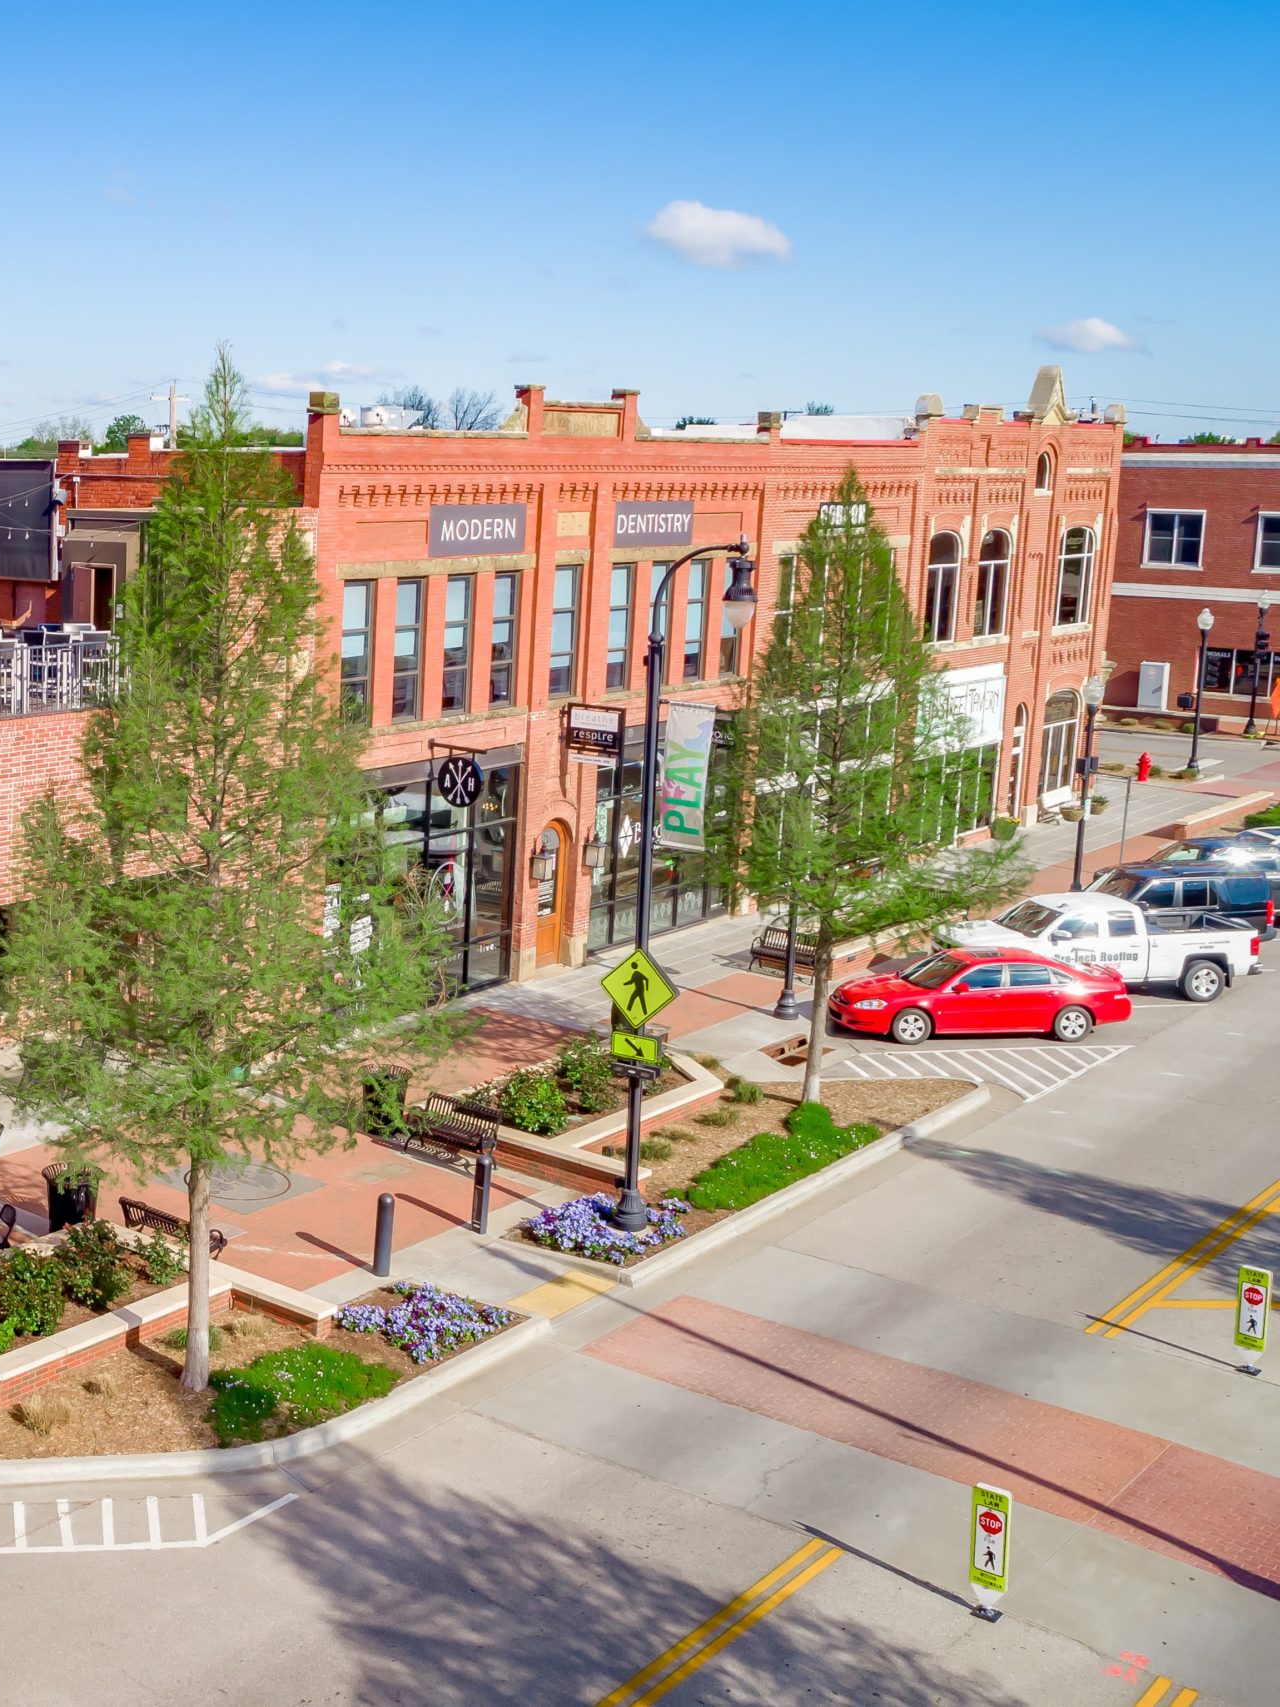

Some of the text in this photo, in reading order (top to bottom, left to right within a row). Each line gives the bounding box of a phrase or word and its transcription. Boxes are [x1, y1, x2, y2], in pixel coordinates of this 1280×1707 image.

[440, 517, 517, 542] MODERN
[616, 513, 692, 535] DENTISTRY
[444, 773, 451, 788] A
[467, 777, 475, 792] H
[663, 740, 706, 837] PLAY
[1100, 952, 1138, 962] Roofing
[1245, 1291, 1263, 1301] STOP
[981, 1490, 1003, 1503] STATE
[984, 1499, 1000, 1509] LAW
[980, 1516, 1001, 1530] STOP
